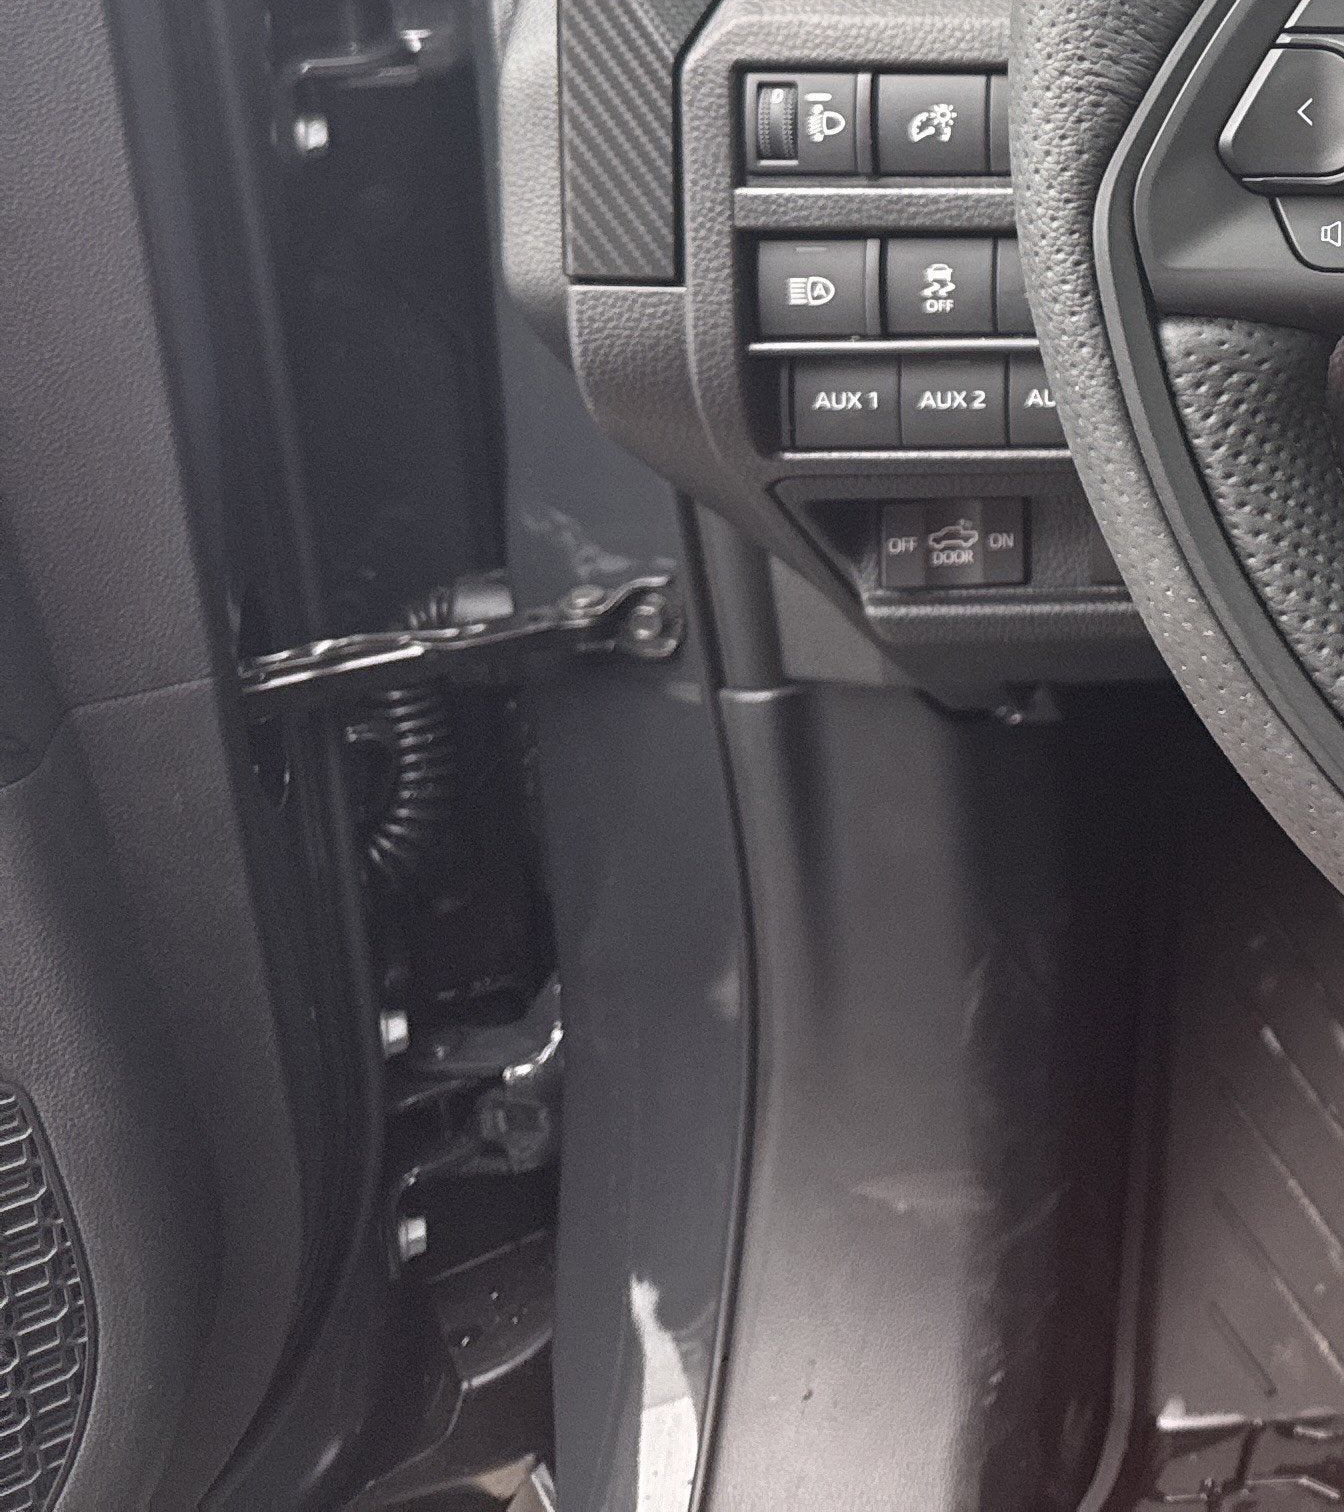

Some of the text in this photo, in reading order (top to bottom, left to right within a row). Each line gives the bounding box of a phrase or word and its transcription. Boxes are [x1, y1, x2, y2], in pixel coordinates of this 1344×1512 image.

[925, 299, 954, 314] OFF
[812, 390, 879, 411] AUX 1
[917, 390, 987, 411] AUX 2
[887, 536, 918, 555] OFF
[988, 533, 1015, 550] ON
[931, 549, 974, 567] DOOR
